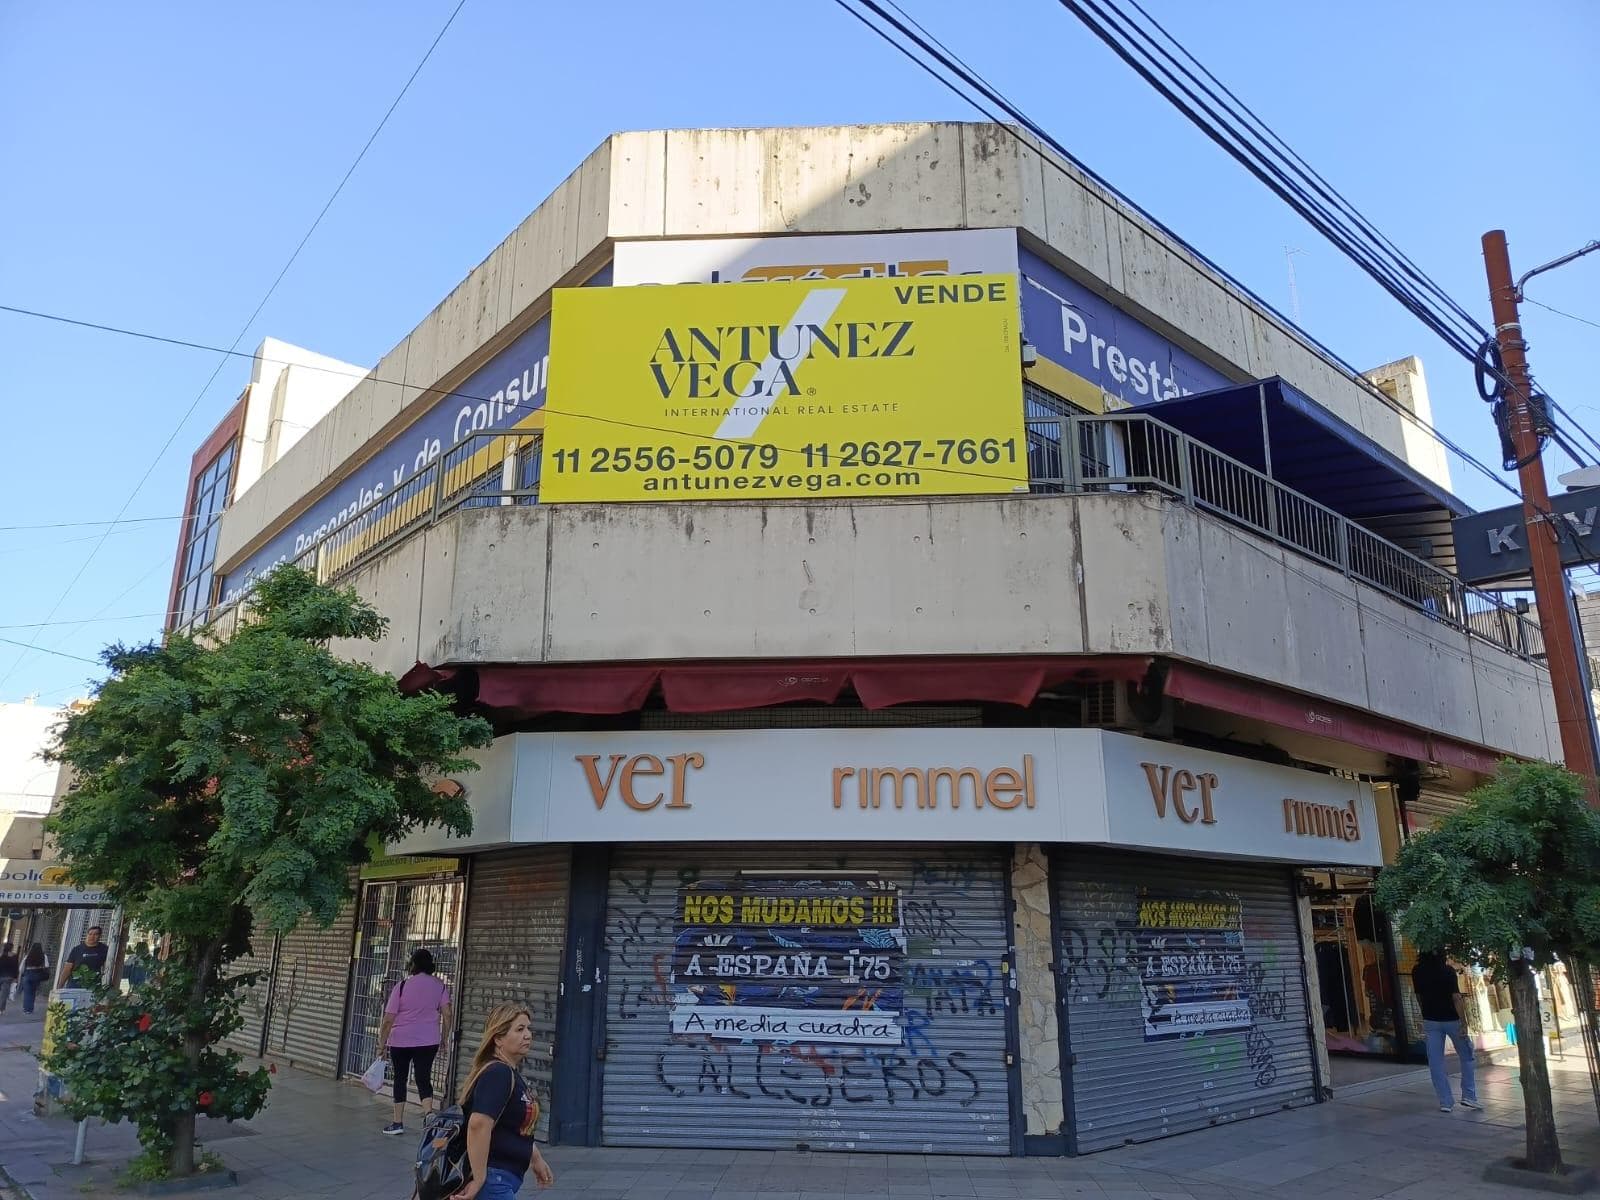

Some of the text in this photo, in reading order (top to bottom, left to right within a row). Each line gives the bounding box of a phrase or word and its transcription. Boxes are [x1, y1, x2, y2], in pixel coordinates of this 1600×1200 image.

[894, 282, 1007, 305] VENDE
[650, 320, 916, 363] ANTUNEZ
[1061, 303, 1195, 402] Presta
[649, 361, 803, 399] VEGA
[664, 402, 900, 418] INTERNATIONAL REAL ESTATE
[413, 438, 442, 483] de
[552, 444, 779, 473] 11 2556-5079
[800, 437, 1017, 468] 11 2627-7661
[642, 468, 921, 492] antunezvega.com
[574, 751, 705, 811] ver
[831, 753, 1036, 809] rimmel
[1140, 761, 1219, 825] ver
[1282, 798, 1361, 842] rimmel
[683, 894, 736, 924] NOS
[741, 895, 865, 925] MUDAMOS
[684, 951, 891, 979] A ESPAÑA 175
[1146, 956, 1155, 978] A
[684, 1013, 894, 1038] A media cuadra
